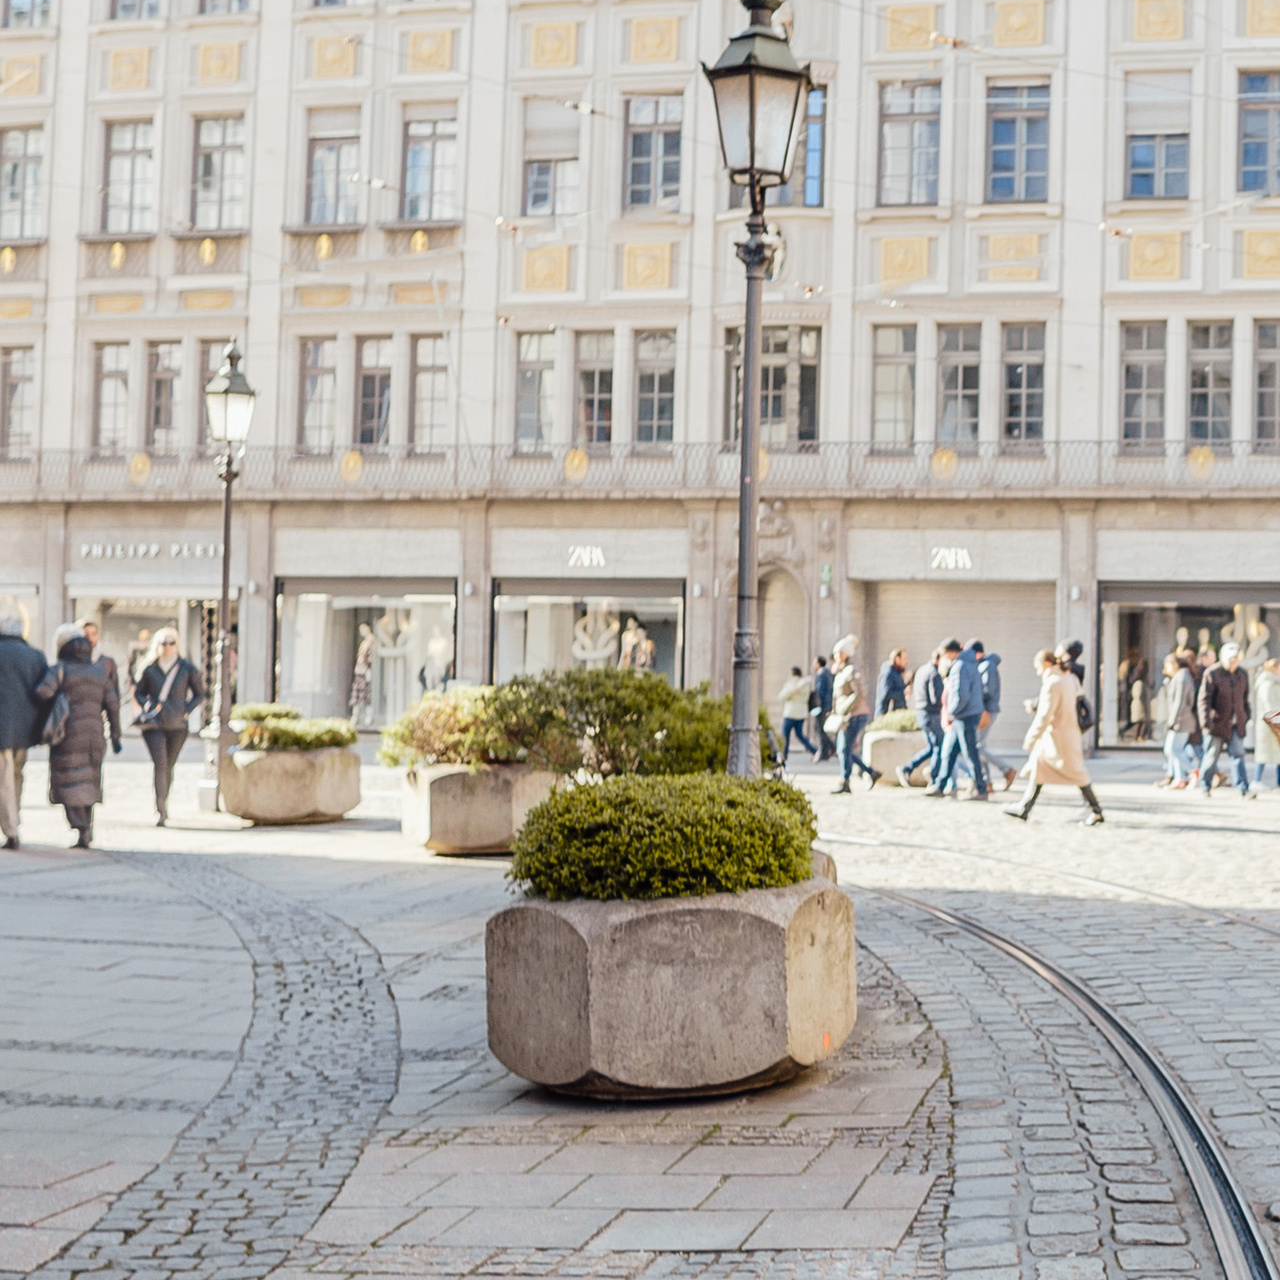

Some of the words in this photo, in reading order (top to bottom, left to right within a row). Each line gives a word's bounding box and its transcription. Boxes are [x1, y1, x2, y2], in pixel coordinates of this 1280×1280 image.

[81, 543, 160, 558] PHILIPP
[568, 545, 606, 568] ZARA
[931, 547, 972, 569] ZARA
